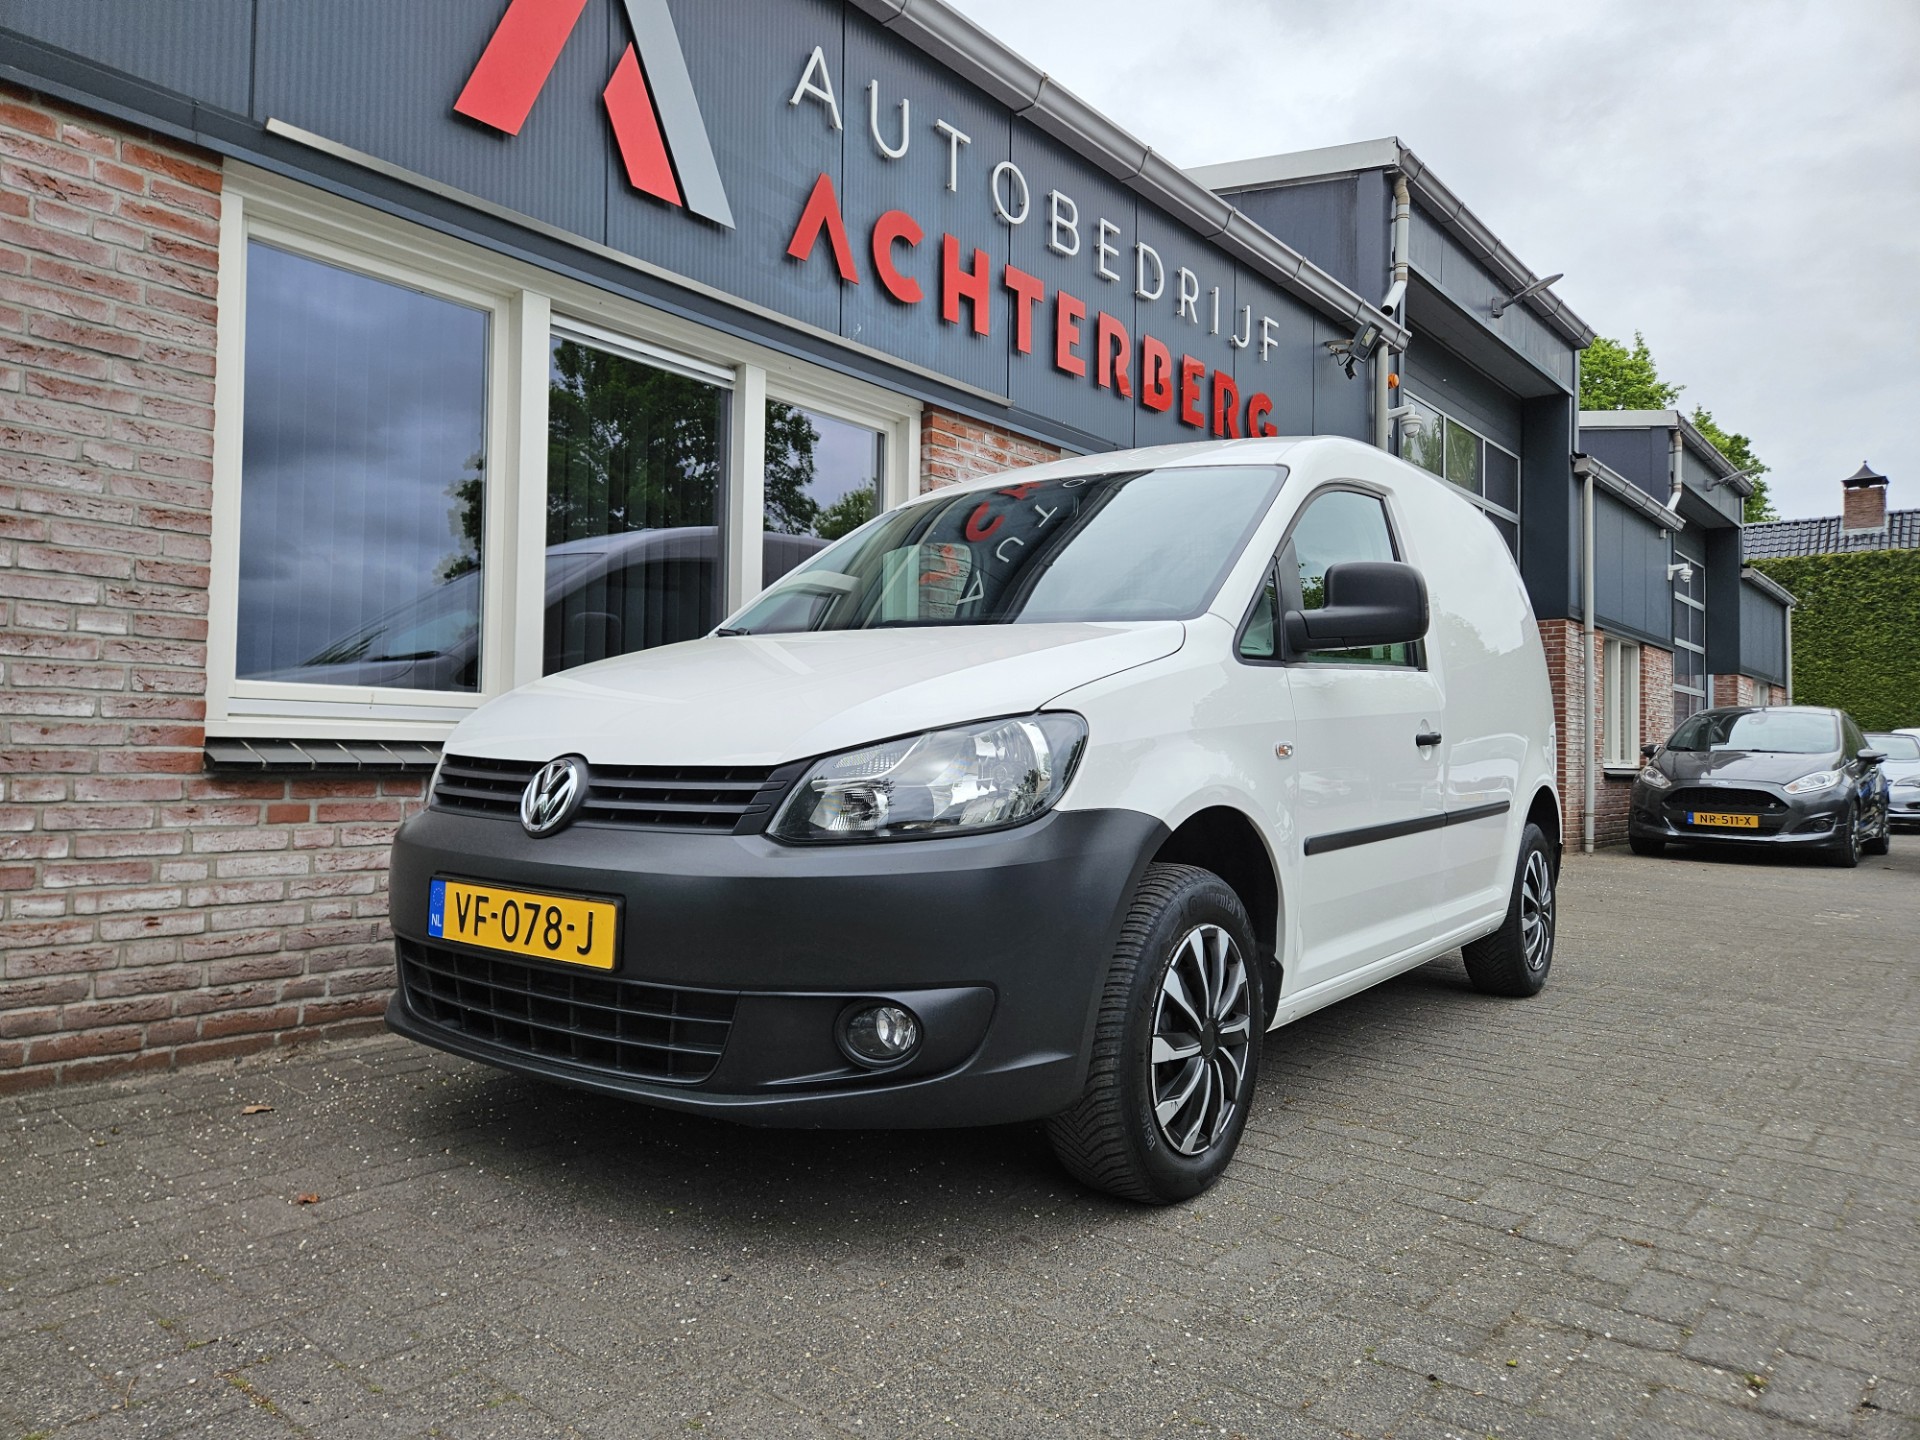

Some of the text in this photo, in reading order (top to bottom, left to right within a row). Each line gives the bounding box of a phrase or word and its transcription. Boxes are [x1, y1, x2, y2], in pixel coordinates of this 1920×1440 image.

[790, 45, 1280, 362] AUTOBEDRIJF
[787, 172, 1278, 440] ACHTERBERG
[1699, 814, 1752, 827] NR-511-X
[430, 912, 443, 928] NL
[455, 891, 595, 956] VF-078-J
